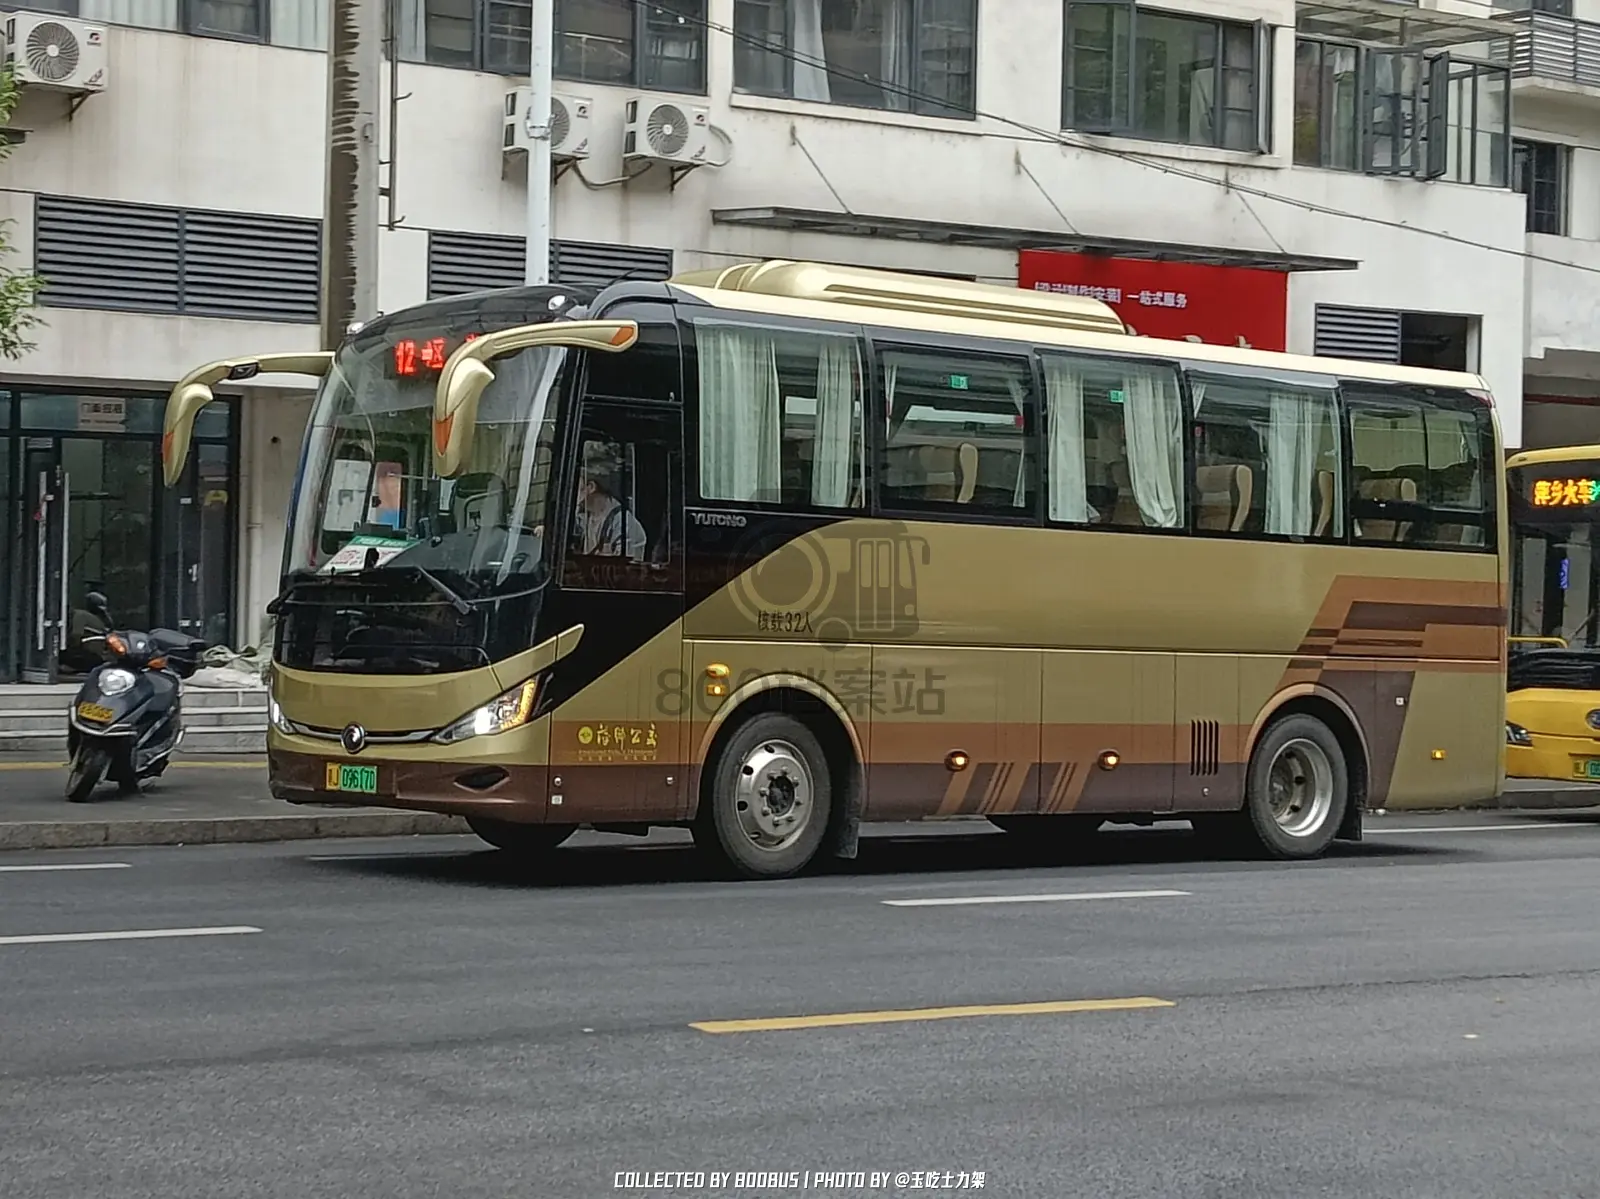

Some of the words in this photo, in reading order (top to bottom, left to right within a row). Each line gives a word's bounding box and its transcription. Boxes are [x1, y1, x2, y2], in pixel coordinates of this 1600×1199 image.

[1126, 290, 1187, 308] 一站式服务
[692, 513, 747, 527] YUTONG
[758, 611, 813, 634] 核载32人
